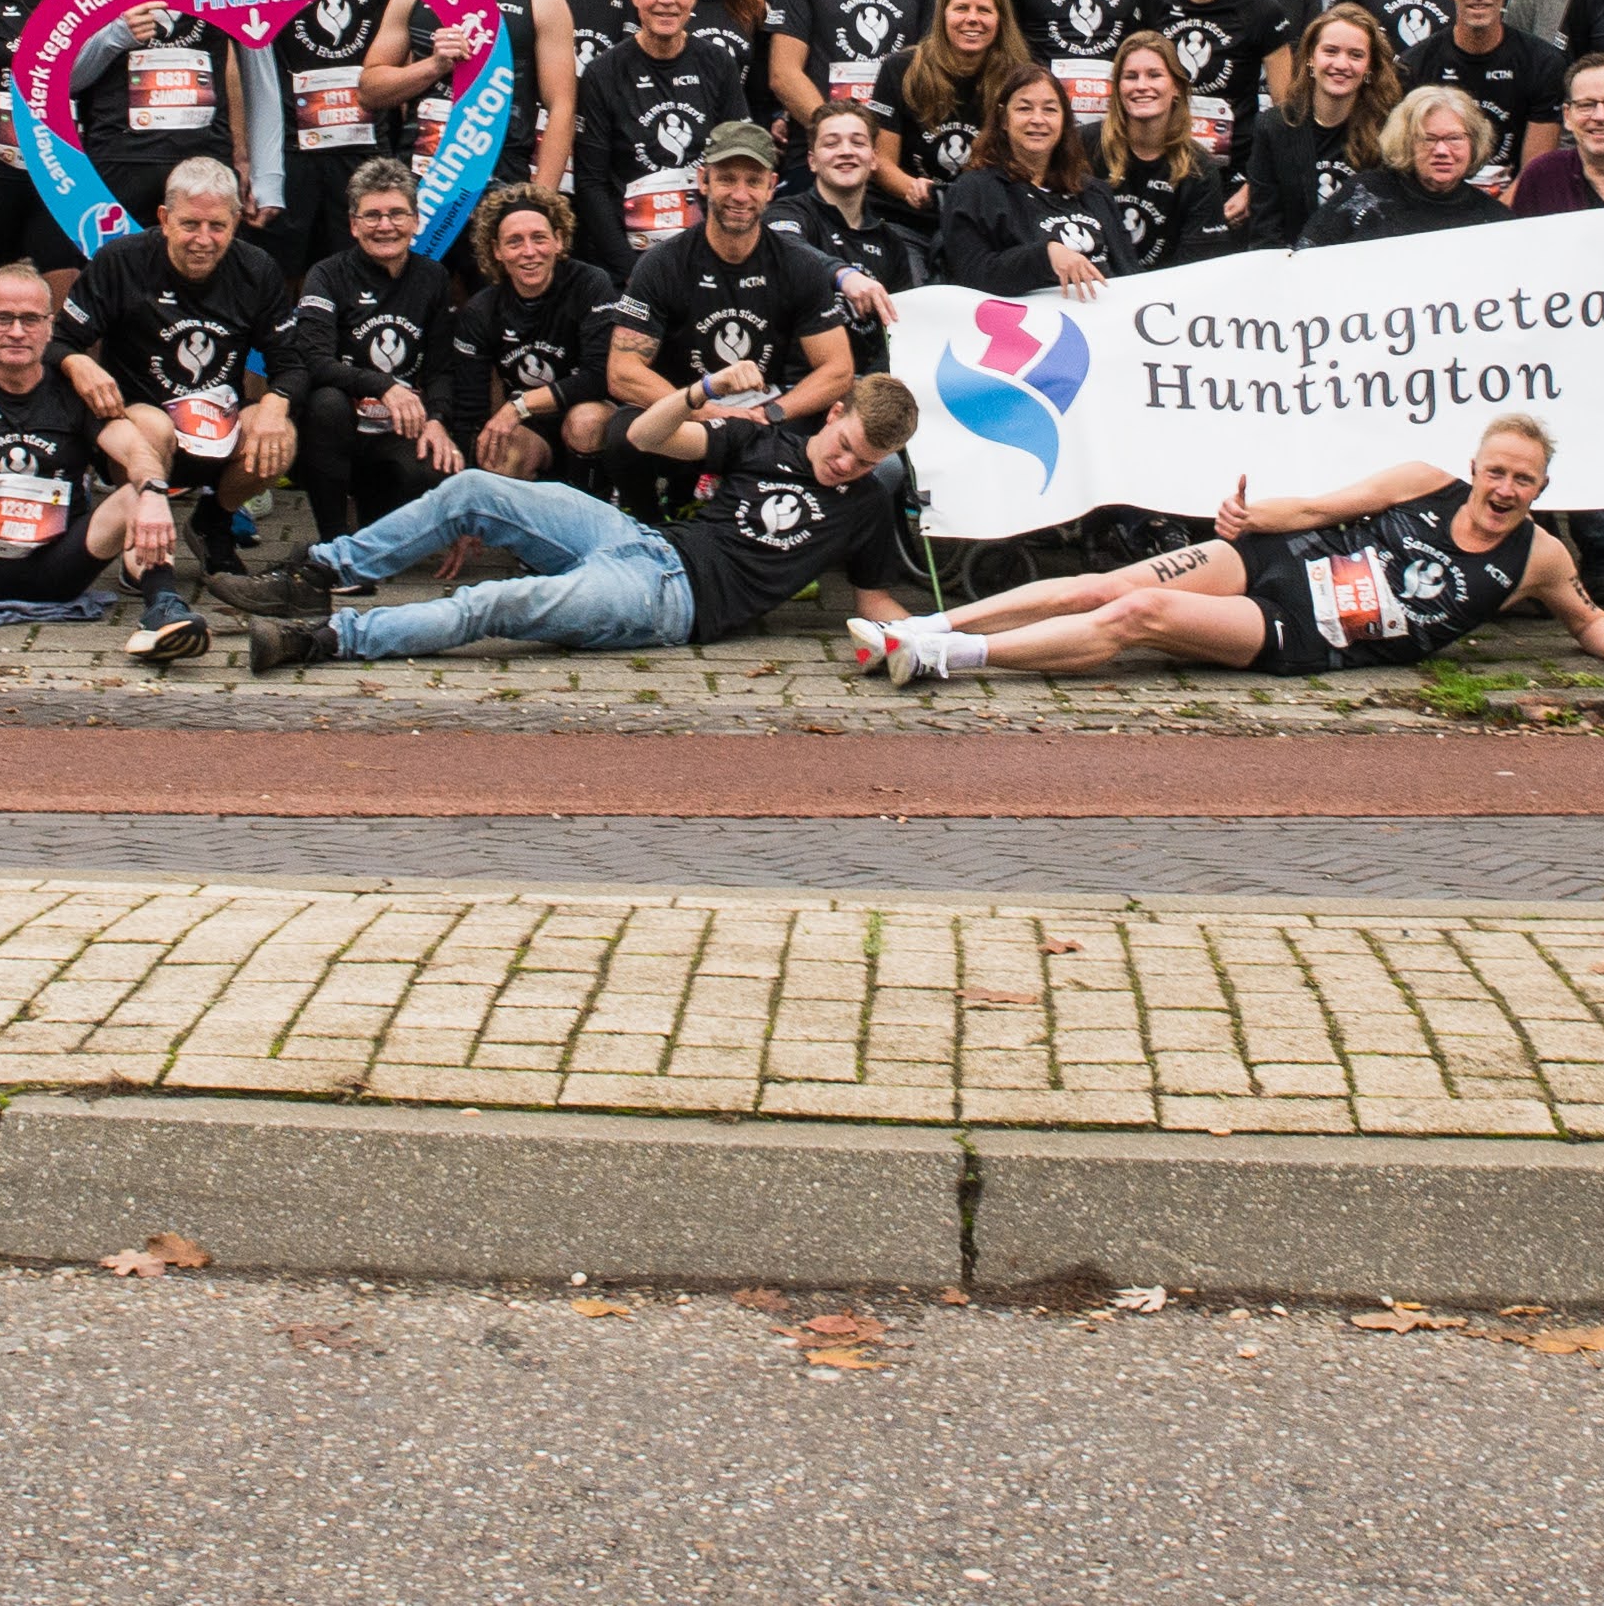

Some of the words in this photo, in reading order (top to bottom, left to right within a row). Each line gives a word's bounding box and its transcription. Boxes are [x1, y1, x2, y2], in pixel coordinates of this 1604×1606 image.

[35, 8, 84, 63] tegen
[147, 18, 207, 50] Huntingto
[316, 18, 373, 59] Huntington
[26, 64, 53, 120] sterk
[32, 124, 77, 195] Samen
[1141, 356, 1563, 426] Huntington
[1149, 547, 1211, 584] #CTH
